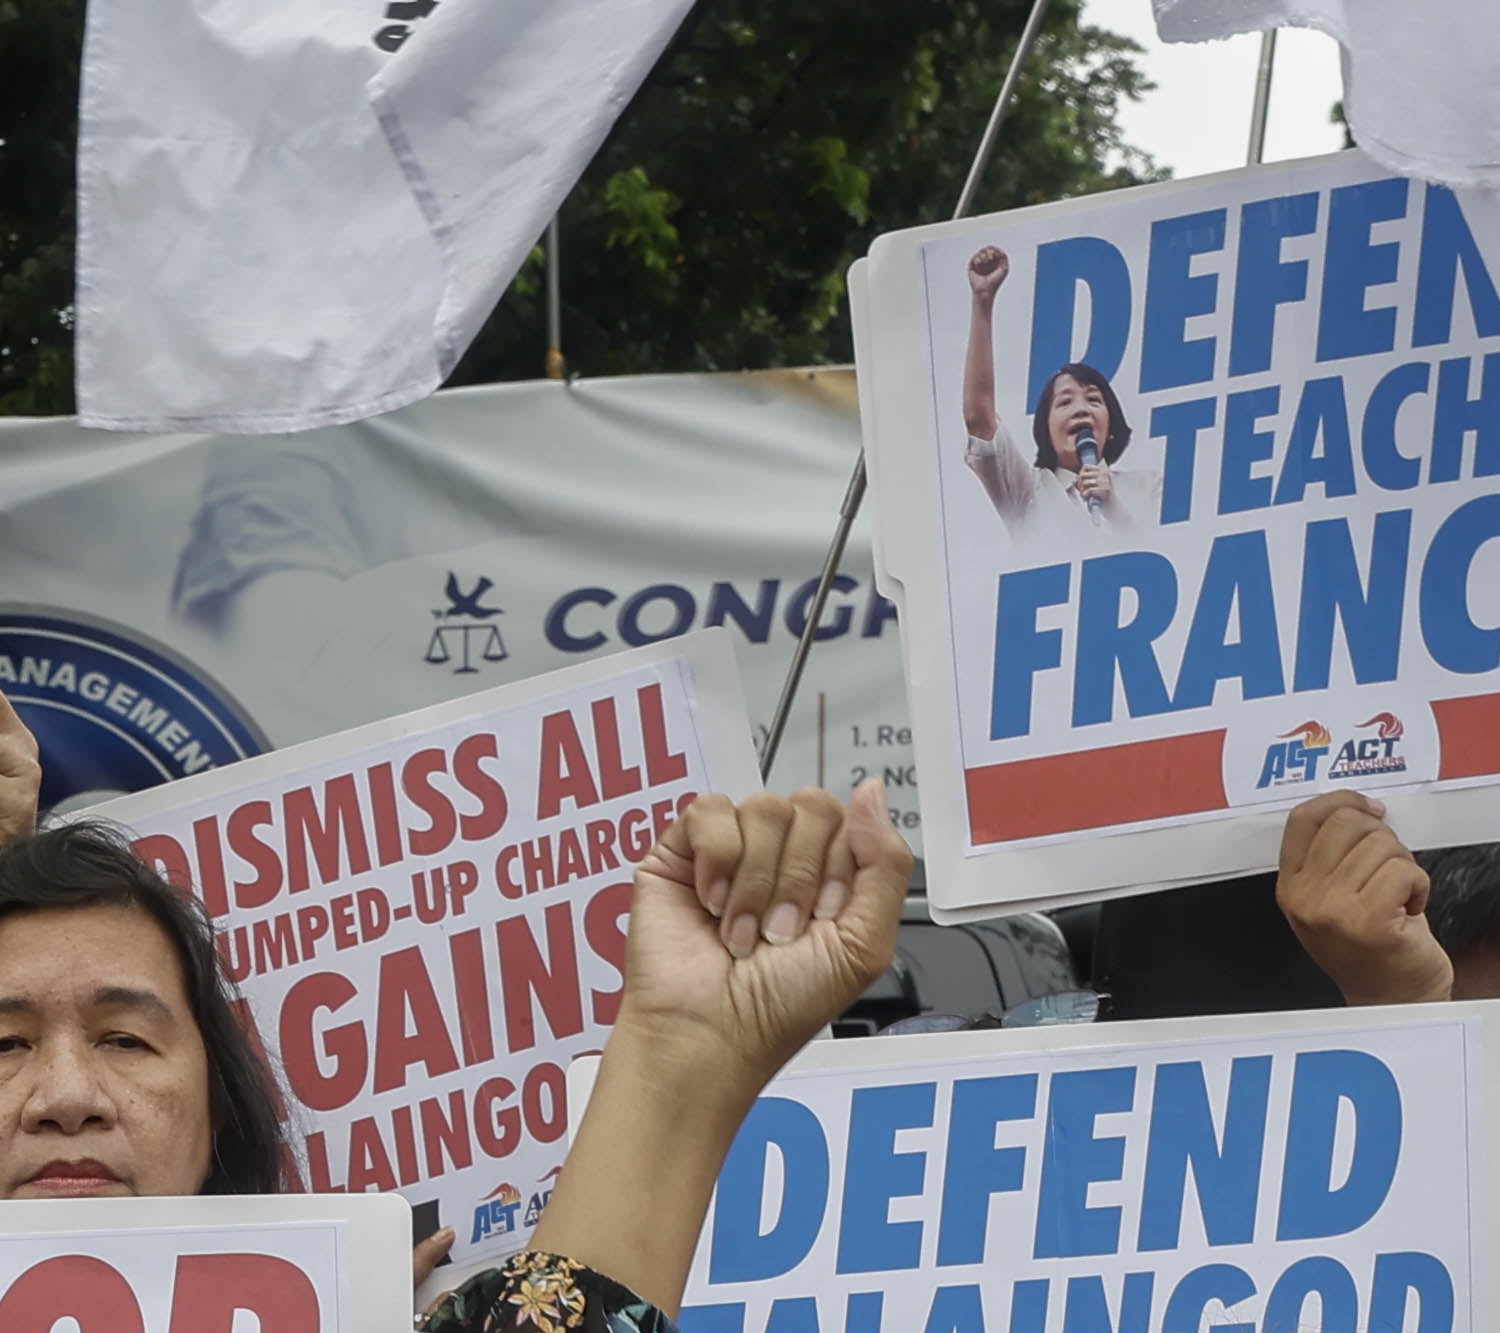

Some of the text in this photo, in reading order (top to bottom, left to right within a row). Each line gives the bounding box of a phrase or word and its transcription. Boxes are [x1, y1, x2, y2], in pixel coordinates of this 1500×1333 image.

[129, 683, 689, 919] DISMISS ALL
[1329, 736, 1401, 772] ACT
[234, 882, 636, 1122] GAINS
[282, 1049, 604, 1194] LAINGO
[706, 1049, 1404, 1286] DEFEND
